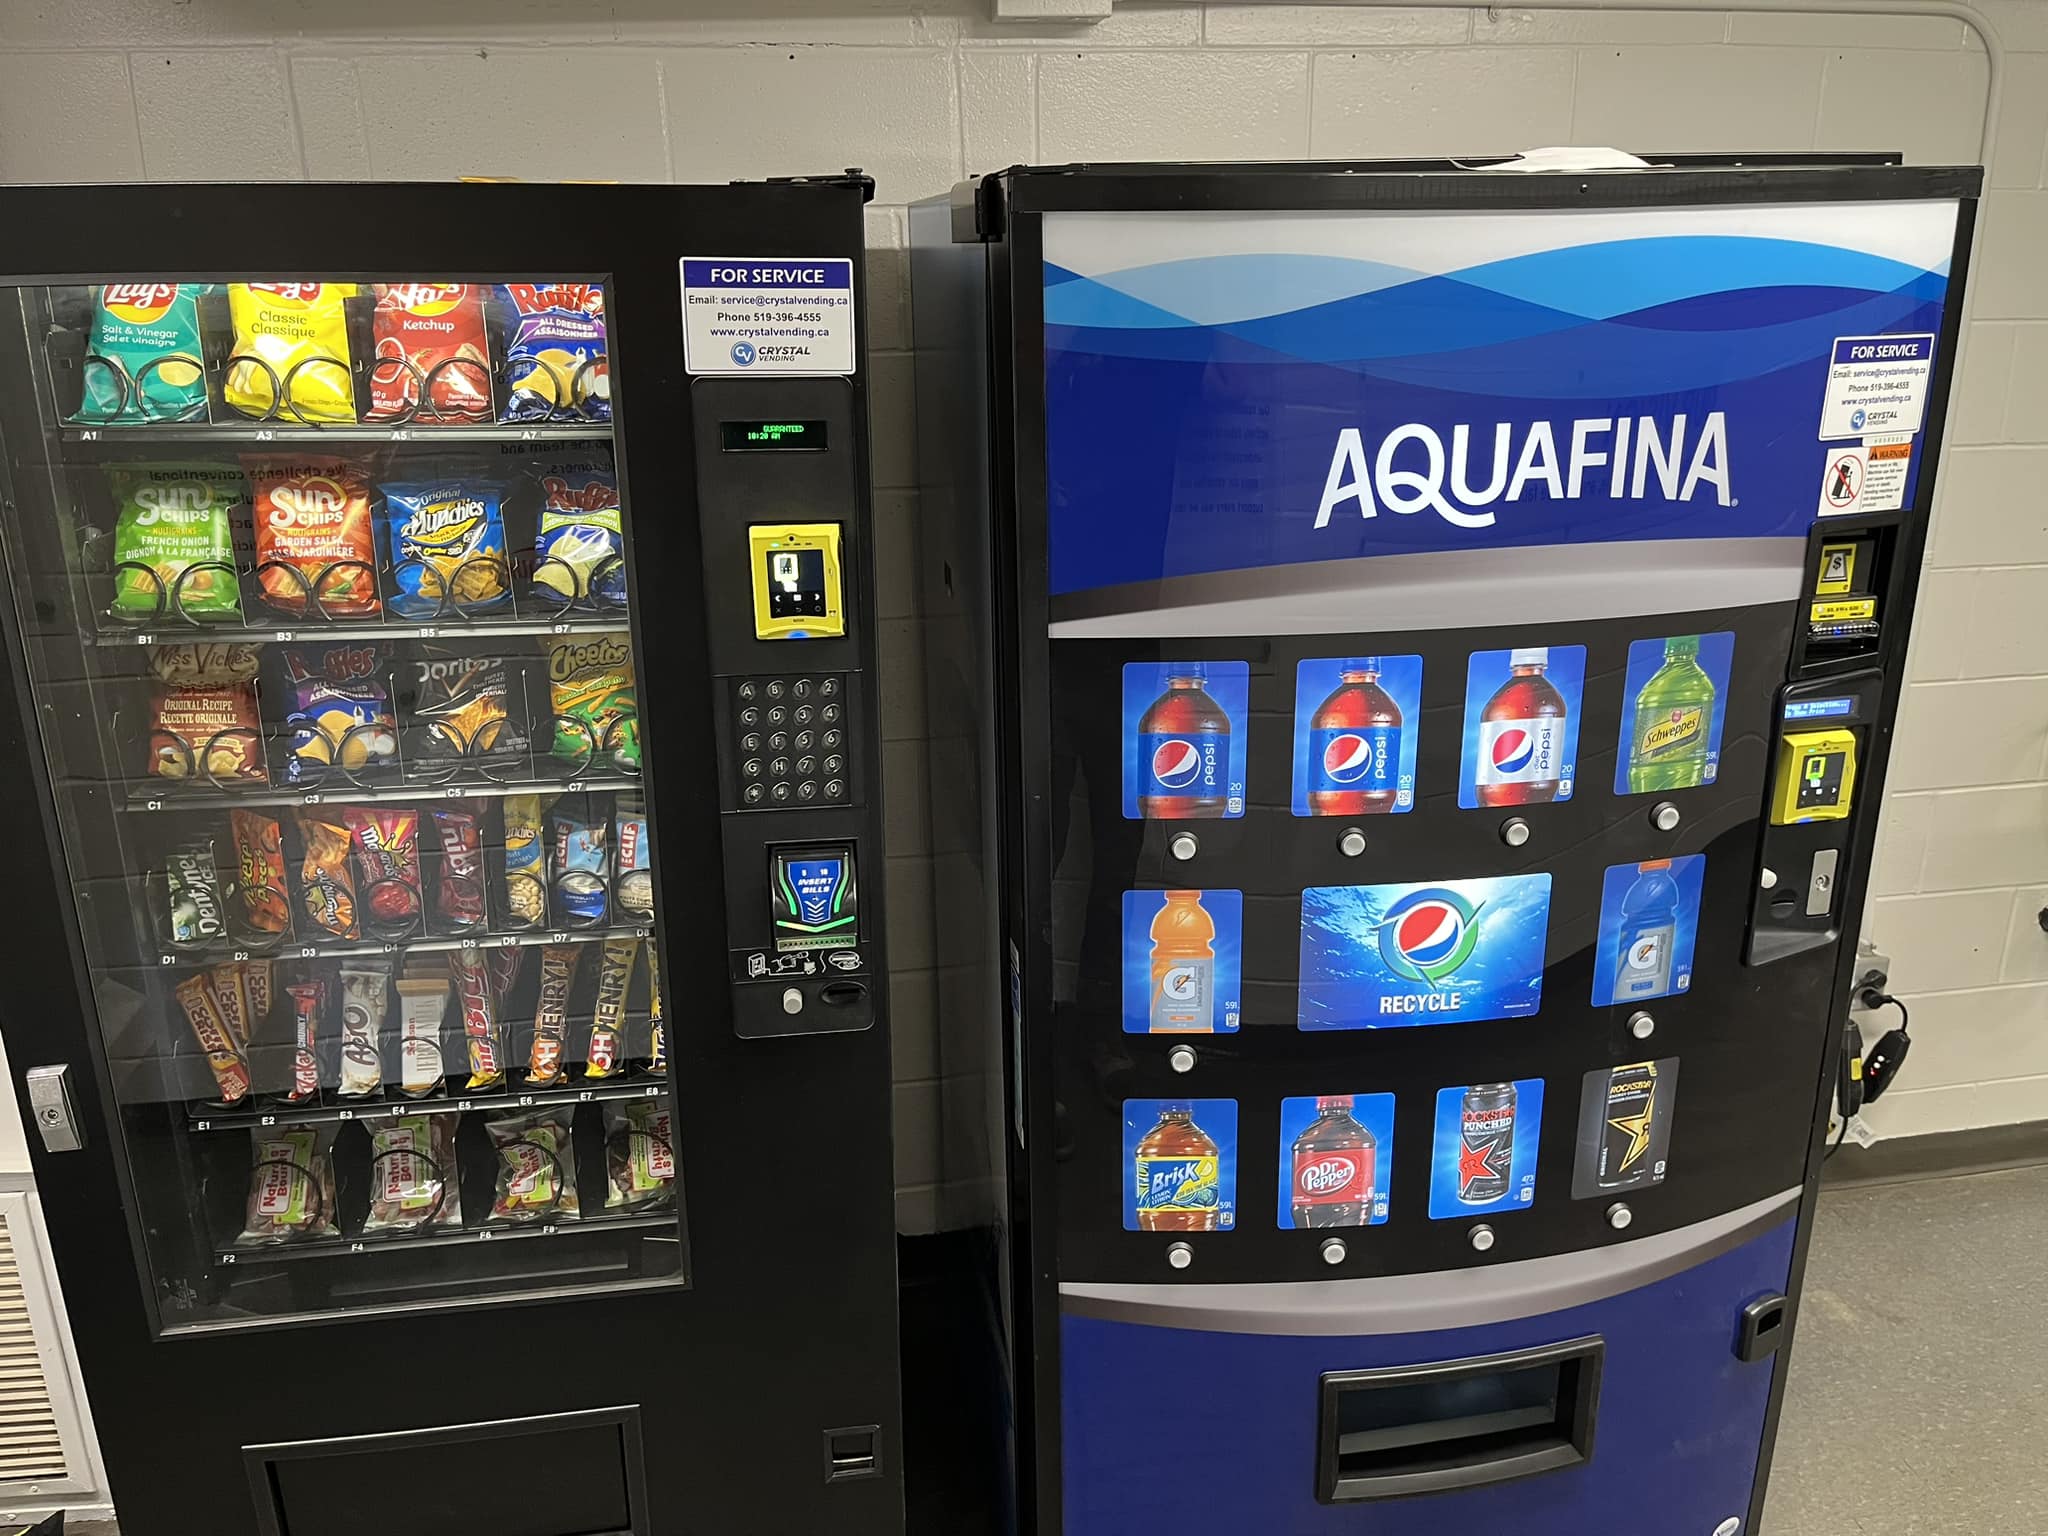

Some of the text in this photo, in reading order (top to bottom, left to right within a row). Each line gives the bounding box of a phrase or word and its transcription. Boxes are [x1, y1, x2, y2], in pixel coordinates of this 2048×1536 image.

[711, 268, 825, 283] FOR SERVICE
[688, 295, 848, 307] Email: service@crystalvending.ca
[259, 310, 307, 325] Classic
[717, 312, 822, 322] Phone 519-396-4555
[251, 323, 316, 338] Classique
[403, 319, 455, 333] Ketchup
[102, 325, 178, 340] Salt & Vinegar
[710, 328, 830, 338] www.crystalvending.ca
[103, 334, 118, 343] Sel
[131, 335, 176, 347] vinaigre
[758, 346, 811, 355] CRYSTAL
[1851, 344, 1919, 359] FOR SERVICE
[1848, 384, 1869, 392] Phone
[1867, 411, 1898, 420] CRYSTAL
[82, 431, 97, 440] A1
[256, 431, 273, 440] A3
[391, 431, 407, 440] A5
[521, 431, 536, 440] A7
[1313, 411, 1731, 530] AQUAFINA
[420, 489, 461, 505] Original
[135, 488, 211, 526] Sun
[270, 487, 346, 528] Sun
[161, 509, 210, 522] CHIPS
[297, 511, 344, 525] CHIPS
[401, 498, 485, 538] Munchies
[142, 536, 209, 545] FRENCH ONION
[275, 537, 344, 547] GARDEN SALSA
[166, 547, 179, 556] LA
[181, 547, 231, 558] FRANÇAISE
[420, 629, 435, 637] B5
[555, 625, 568, 633] B7
[138, 635, 151, 644] B1
[277, 632, 292, 642] B3
[550, 640, 629, 681] Cheetos
[164, 699, 233, 711] ORIGINAL RECIPE
[160, 711, 237, 724] RECETTE ORIGINALE
[1645, 718, 1696, 748] Schweppes
[1540, 728, 1551, 769] pepsi
[1375, 736, 1387, 779] pepsi
[1203, 743, 1216, 786] pepsi
[1561, 764, 1572, 773] 20
[1400, 775, 1412, 783] 20
[568, 783, 582, 791] C7
[1230, 782, 1242, 791] 20
[447, 788, 461, 797] C5
[305, 795, 319, 803] C3
[148, 801, 161, 810] C1
[199, 865, 216, 883] ICE
[798, 878, 834, 886] INSERT
[802, 886, 830, 894] BILLS
[463, 939, 476, 947] D5
[554, 934, 567, 942] D7
[302, 948, 316, 957] D3
[385, 944, 398, 953] D4
[1628, 936, 1658, 969] G
[162, 956, 175, 965] D1
[234, 952, 248, 961] D2
[1163, 966, 1196, 1000] G
[1380, 992, 1461, 1014] RECYCLE
[592, 947, 632, 1070] OH HENRY!
[533, 959, 568, 1076] OH HENRY!
[298, 1015, 307, 1048] CHUNKY
[646, 1088, 658, 1096] E8
[1610, 1080, 1652, 1095] ROCKSTAR
[520, 1097, 532, 1105] E6
[580, 1092, 592, 1101] E7
[392, 1107, 405, 1115] E4
[458, 1102, 471, 1110] E5
[340, 1111, 352, 1120] E3
[1462, 1106, 1515, 1122] ROCKSTAR
[198, 1121, 210, 1130] E1
[262, 1117, 275, 1126] E2
[1463, 1117, 1512, 1131] PUNCHED
[1320, 1162, 1338, 1177] Dr
[1307, 1166, 1350, 1191] Pepper
[480, 1231, 492, 1239] F6
[352, 1243, 364, 1252] F4
[223, 1255, 236, 1264] F2
